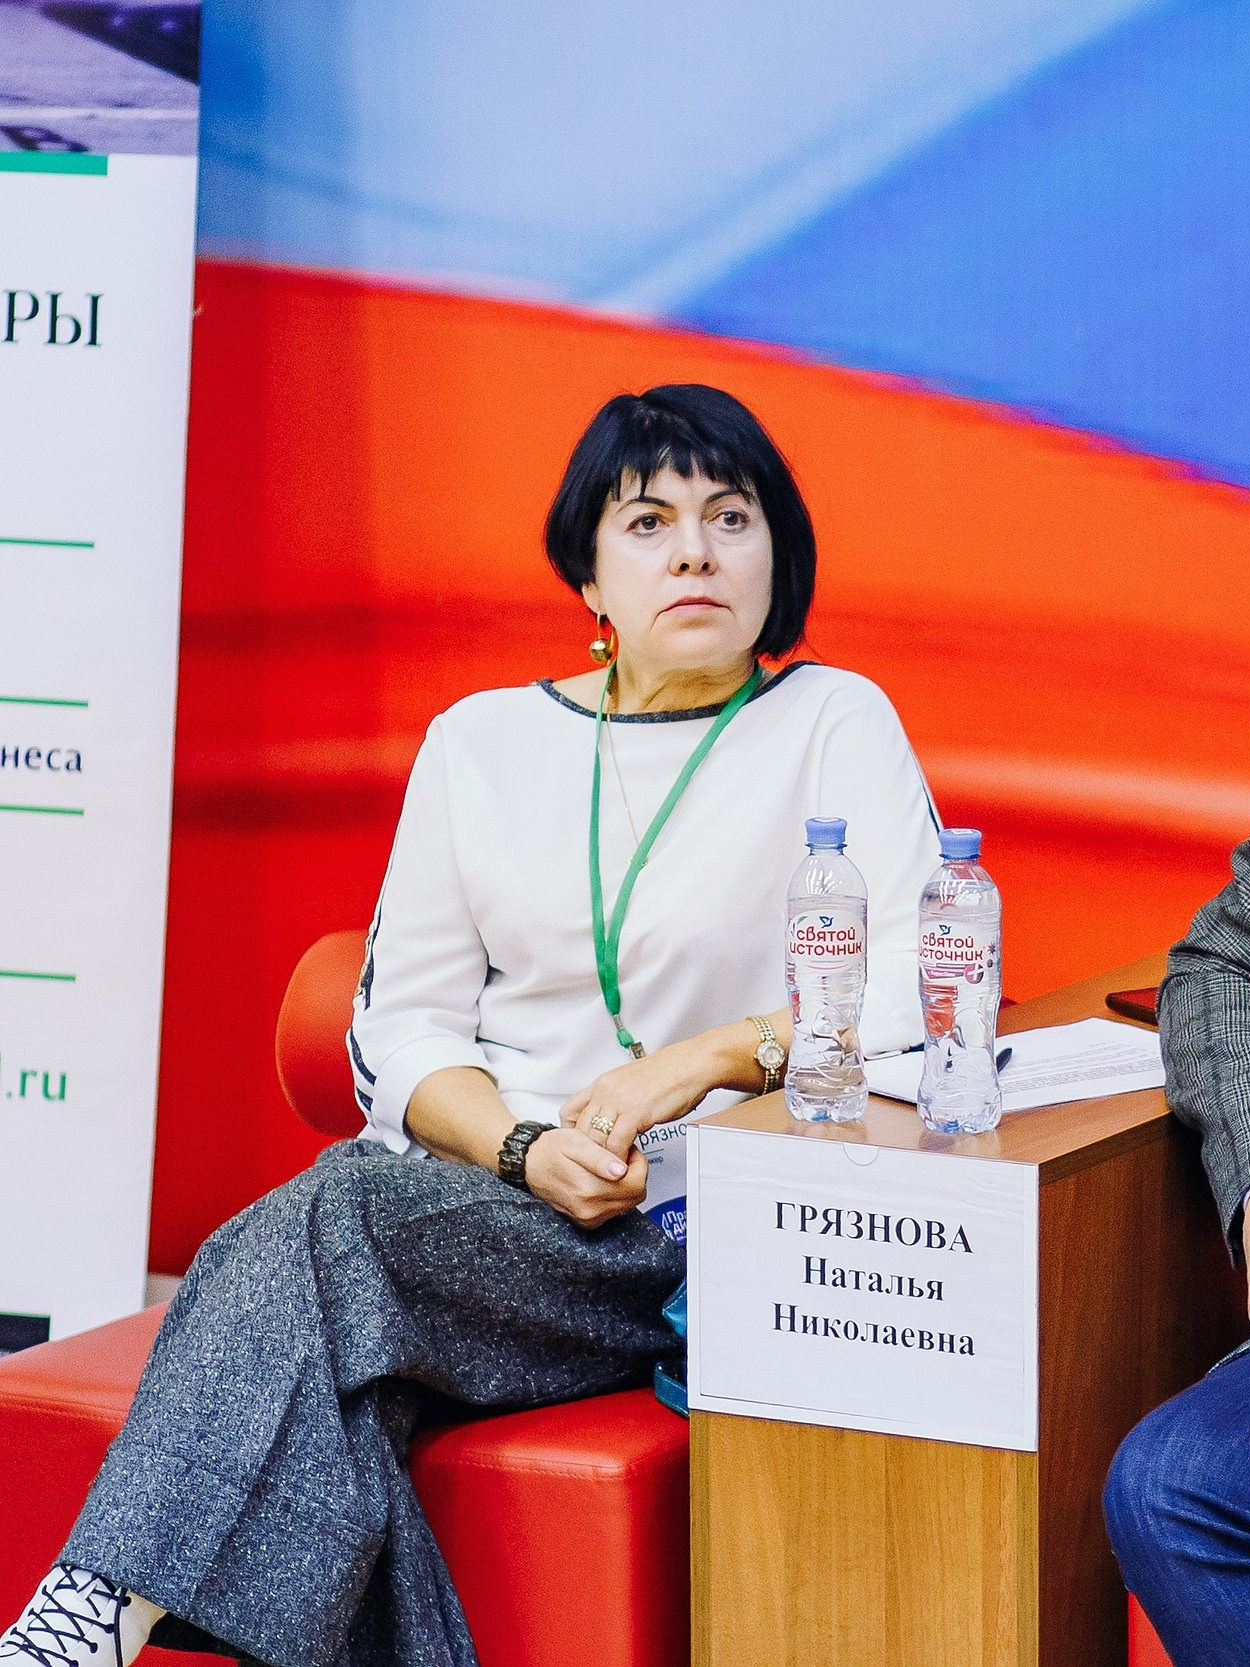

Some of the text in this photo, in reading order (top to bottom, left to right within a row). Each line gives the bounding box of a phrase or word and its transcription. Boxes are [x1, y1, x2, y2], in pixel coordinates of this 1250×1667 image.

[2, 289, 104, 349] РЫ
[1, 745, 82, 773] неса
[796, 926, 856, 942] святой
[922, 932, 974, 948] святой
[774, 1201, 974, 1254] ГРЯЗНОВА
[801, 1255, 945, 1301] Наталья
[771, 1302, 976, 1356] Николаевна
